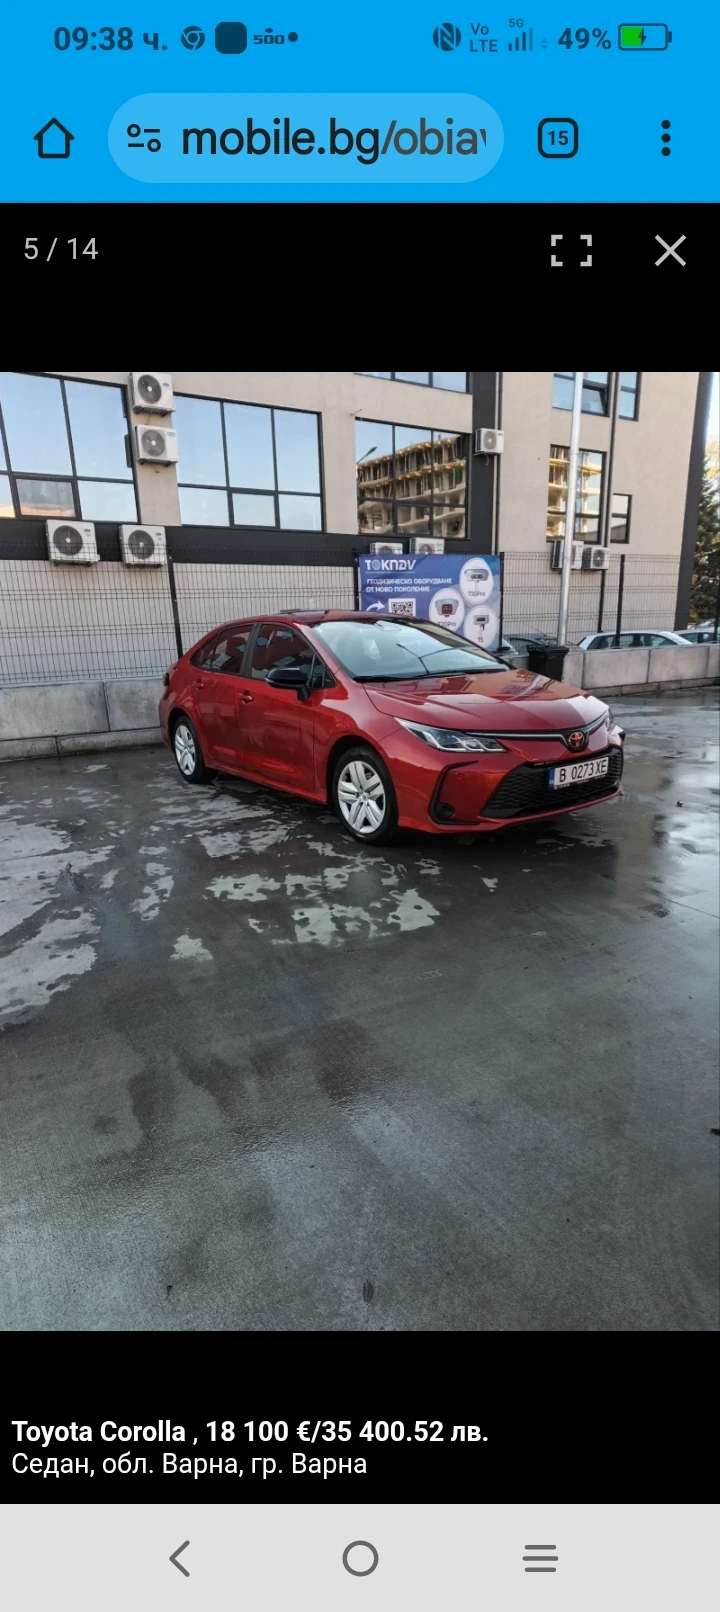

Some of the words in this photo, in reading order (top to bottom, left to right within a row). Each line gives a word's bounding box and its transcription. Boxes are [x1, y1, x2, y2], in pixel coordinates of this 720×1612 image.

[470, 23, 490, 36] Vo
[508, 18, 524, 28] 5G
[53, 26, 134, 51] 09:38
[142, 32, 168, 51] ч.
[469, 39, 498, 53] LTE
[557, 27, 612, 50] 49%
[547, 130, 569, 146] 15
[23, 237, 39, 260] 5
[67, 237, 99, 260] 14
[394, 585, 430, 593] ПОКОЛЕНИЕ
[413, 577, 453, 585] ОБОРУДВАНЕ
[559, 768, 567, 783] B
[571, 762, 594, 780] 0273
[10, 1420, 93, 1448] Toyota
[99, 1419, 186, 1442] Corolla
[206, 1420, 236, 1442] 18
[243, 1420, 289, 1442] 100
[296, 1420, 352, 1444] €/35
[358, 1420, 445, 1442] 400.52
[450, 1425, 489, 1442] лв.
[11, 1452, 95, 1479] Седан,
[102, 1450, 154, 1474] обл.
[162, 1452, 244, 1480] Варна,
[251, 1457, 283, 1480] гр.
[292, 1452, 367, 1480] Варна
